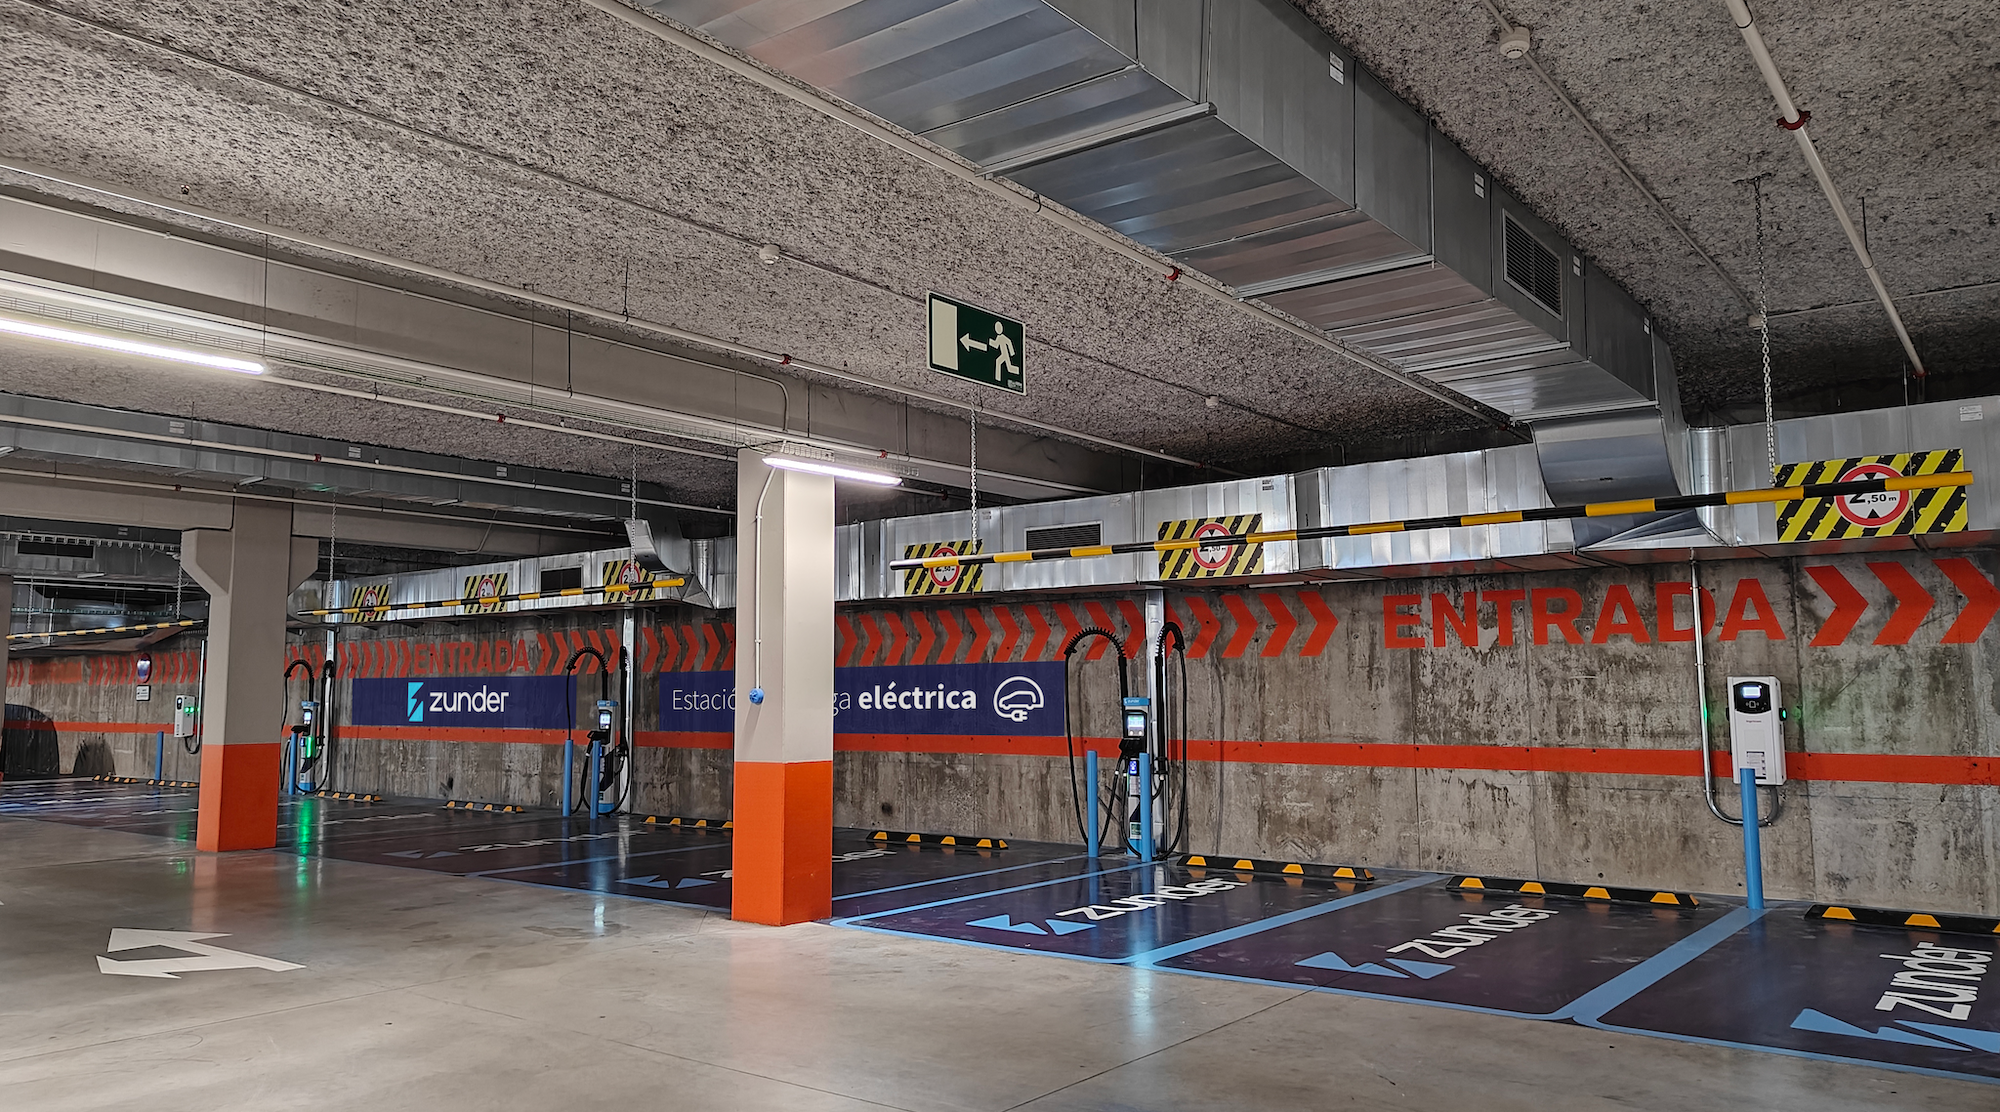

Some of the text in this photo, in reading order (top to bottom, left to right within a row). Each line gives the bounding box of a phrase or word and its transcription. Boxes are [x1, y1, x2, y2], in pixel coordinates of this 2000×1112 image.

[1382, 578, 1787, 649] ENTRADA
[413, 639, 530, 675] ENTRADA
[429, 685, 509, 712] zunder
[672, 687, 736, 711] Estació
[858, 681, 977, 710] eléctrica
[1055, 878, 1248, 921] zunder
[1386, 903, 1559, 958] zunder
[1874, 941, 1993, 1020] zunder
